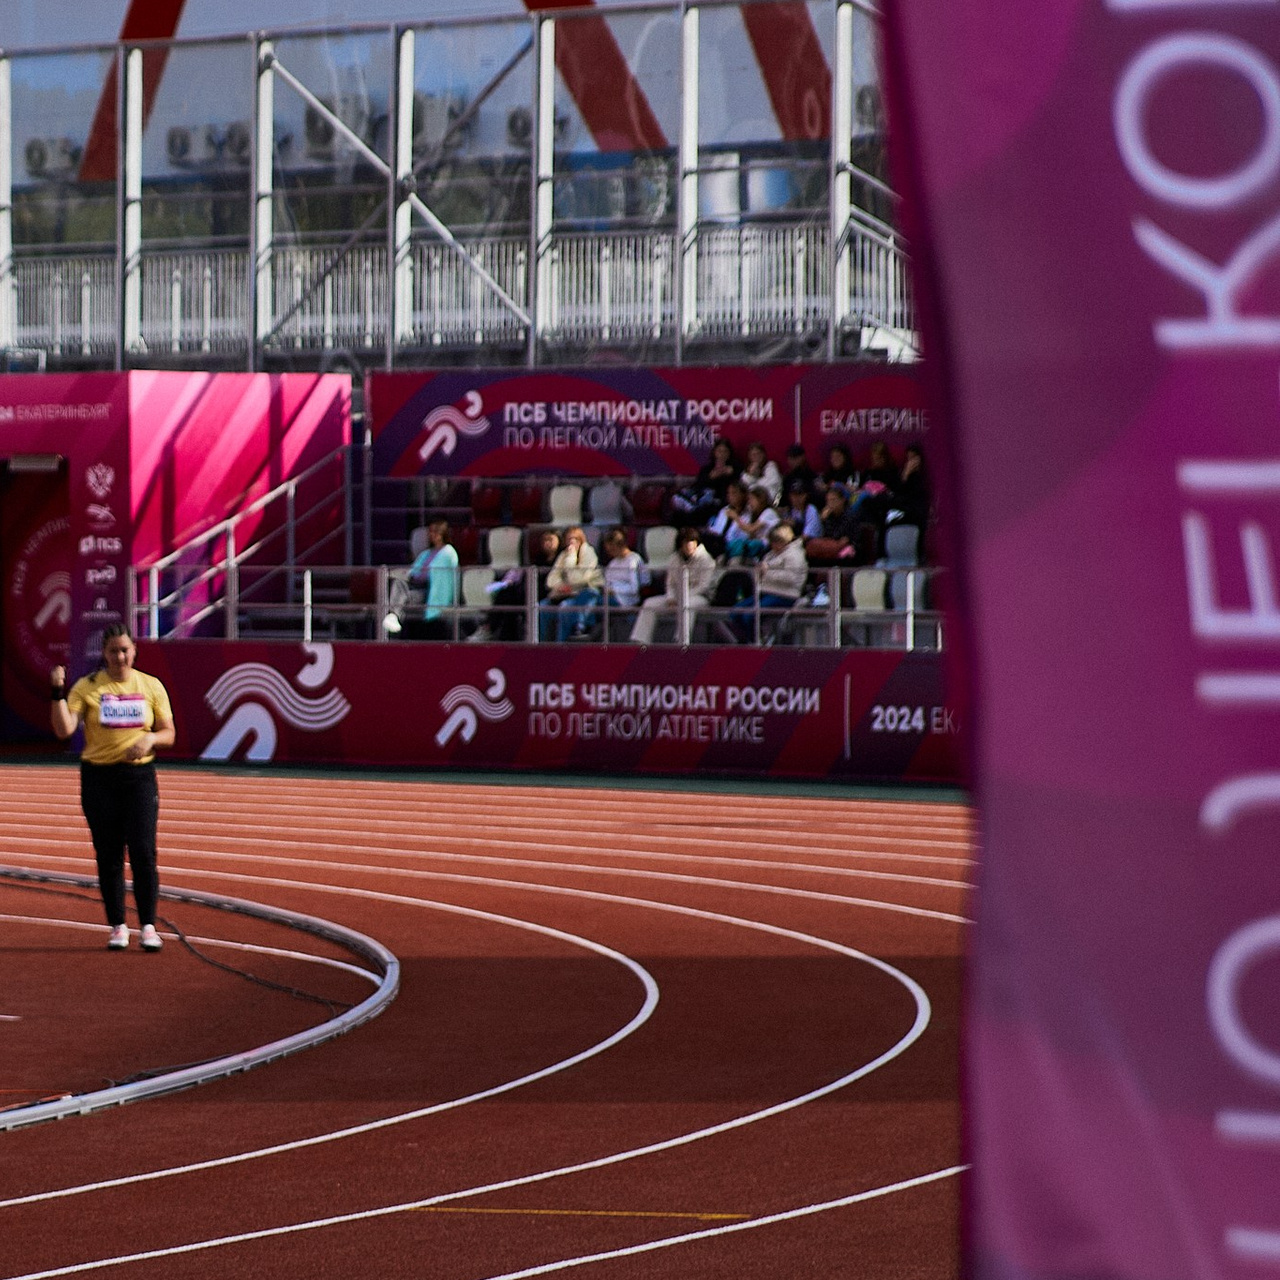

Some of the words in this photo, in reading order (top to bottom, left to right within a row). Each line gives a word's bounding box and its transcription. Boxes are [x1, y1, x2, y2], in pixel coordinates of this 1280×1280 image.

[504, 401, 547, 423] ПСБ
[553, 400, 681, 423] ЧЕМПИОНАТ
[685, 398, 773, 422] РОССИИ
[505, 426, 536, 450] ПО
[539, 422, 618, 450] ЛЕГКОЙ
[529, 682, 576, 708] ПСБ
[581, 683, 721, 710] ЧЕМПИОНАТ
[725, 685, 820, 713] РОССИИ
[529, 711, 562, 739] ПО
[566, 707, 652, 740] ЛЕГКОЙ
[656, 713, 765, 743] АТЛЕТИКЕ
[870, 705, 926, 734] 2024
